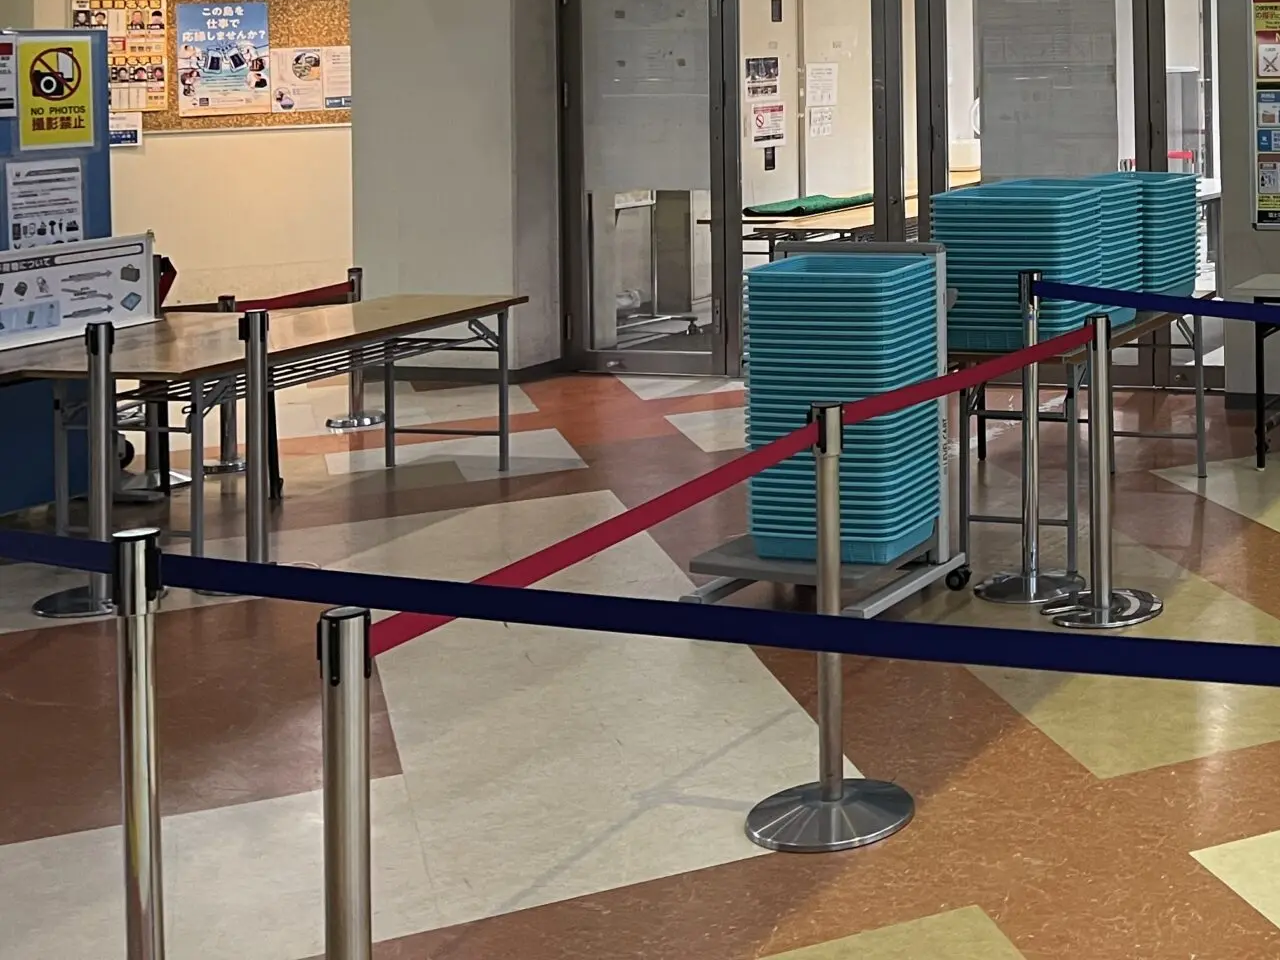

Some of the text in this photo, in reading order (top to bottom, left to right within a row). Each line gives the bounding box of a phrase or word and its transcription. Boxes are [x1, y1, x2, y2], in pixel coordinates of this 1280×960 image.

[202, 5, 245, 17] この島を
[206, 18, 240, 30] 仕事で
[30, 105, 86, 116] NO PHOTOS
